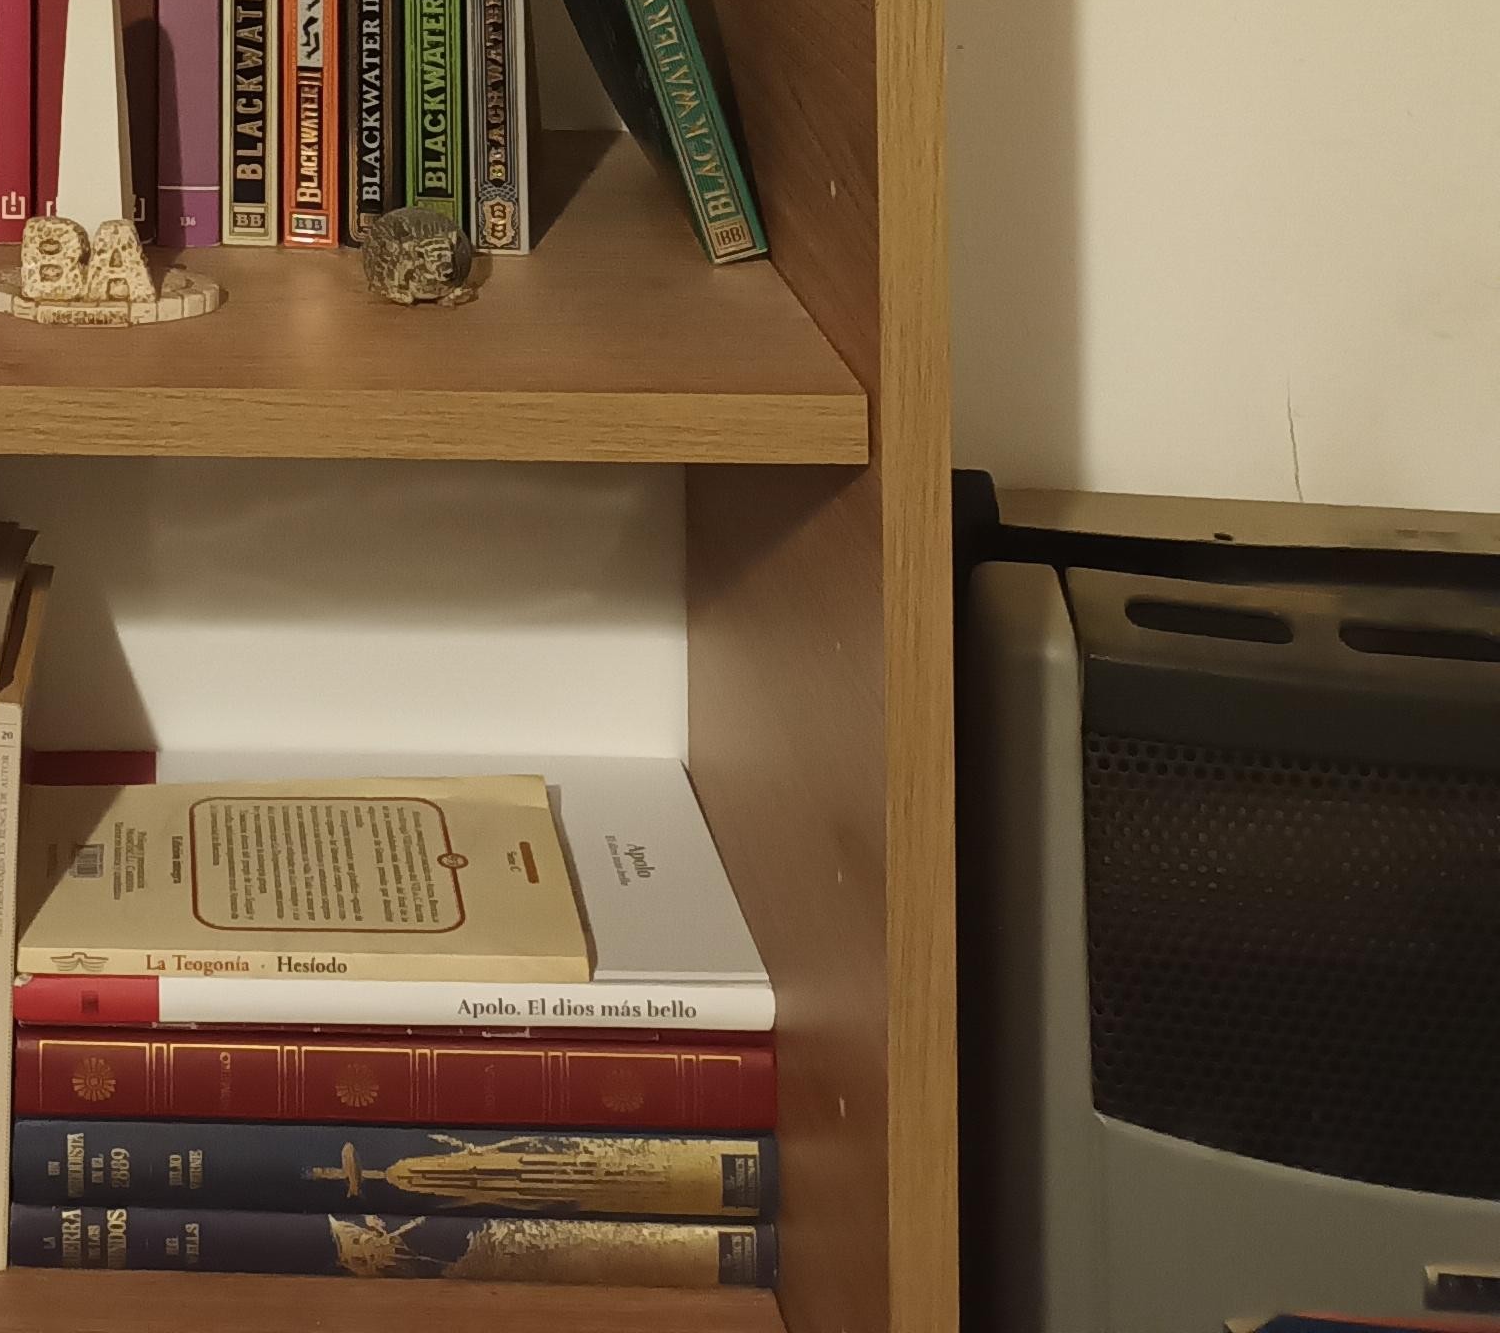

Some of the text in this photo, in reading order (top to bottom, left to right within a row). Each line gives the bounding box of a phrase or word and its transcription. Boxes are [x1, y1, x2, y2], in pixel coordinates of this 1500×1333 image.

[360, 14, 382, 203] BLACKWATER
[145, 954, 348, 976] La Teogonía Hesíodo
[457, 999, 697, 1021] Apolo. El dios más bello
